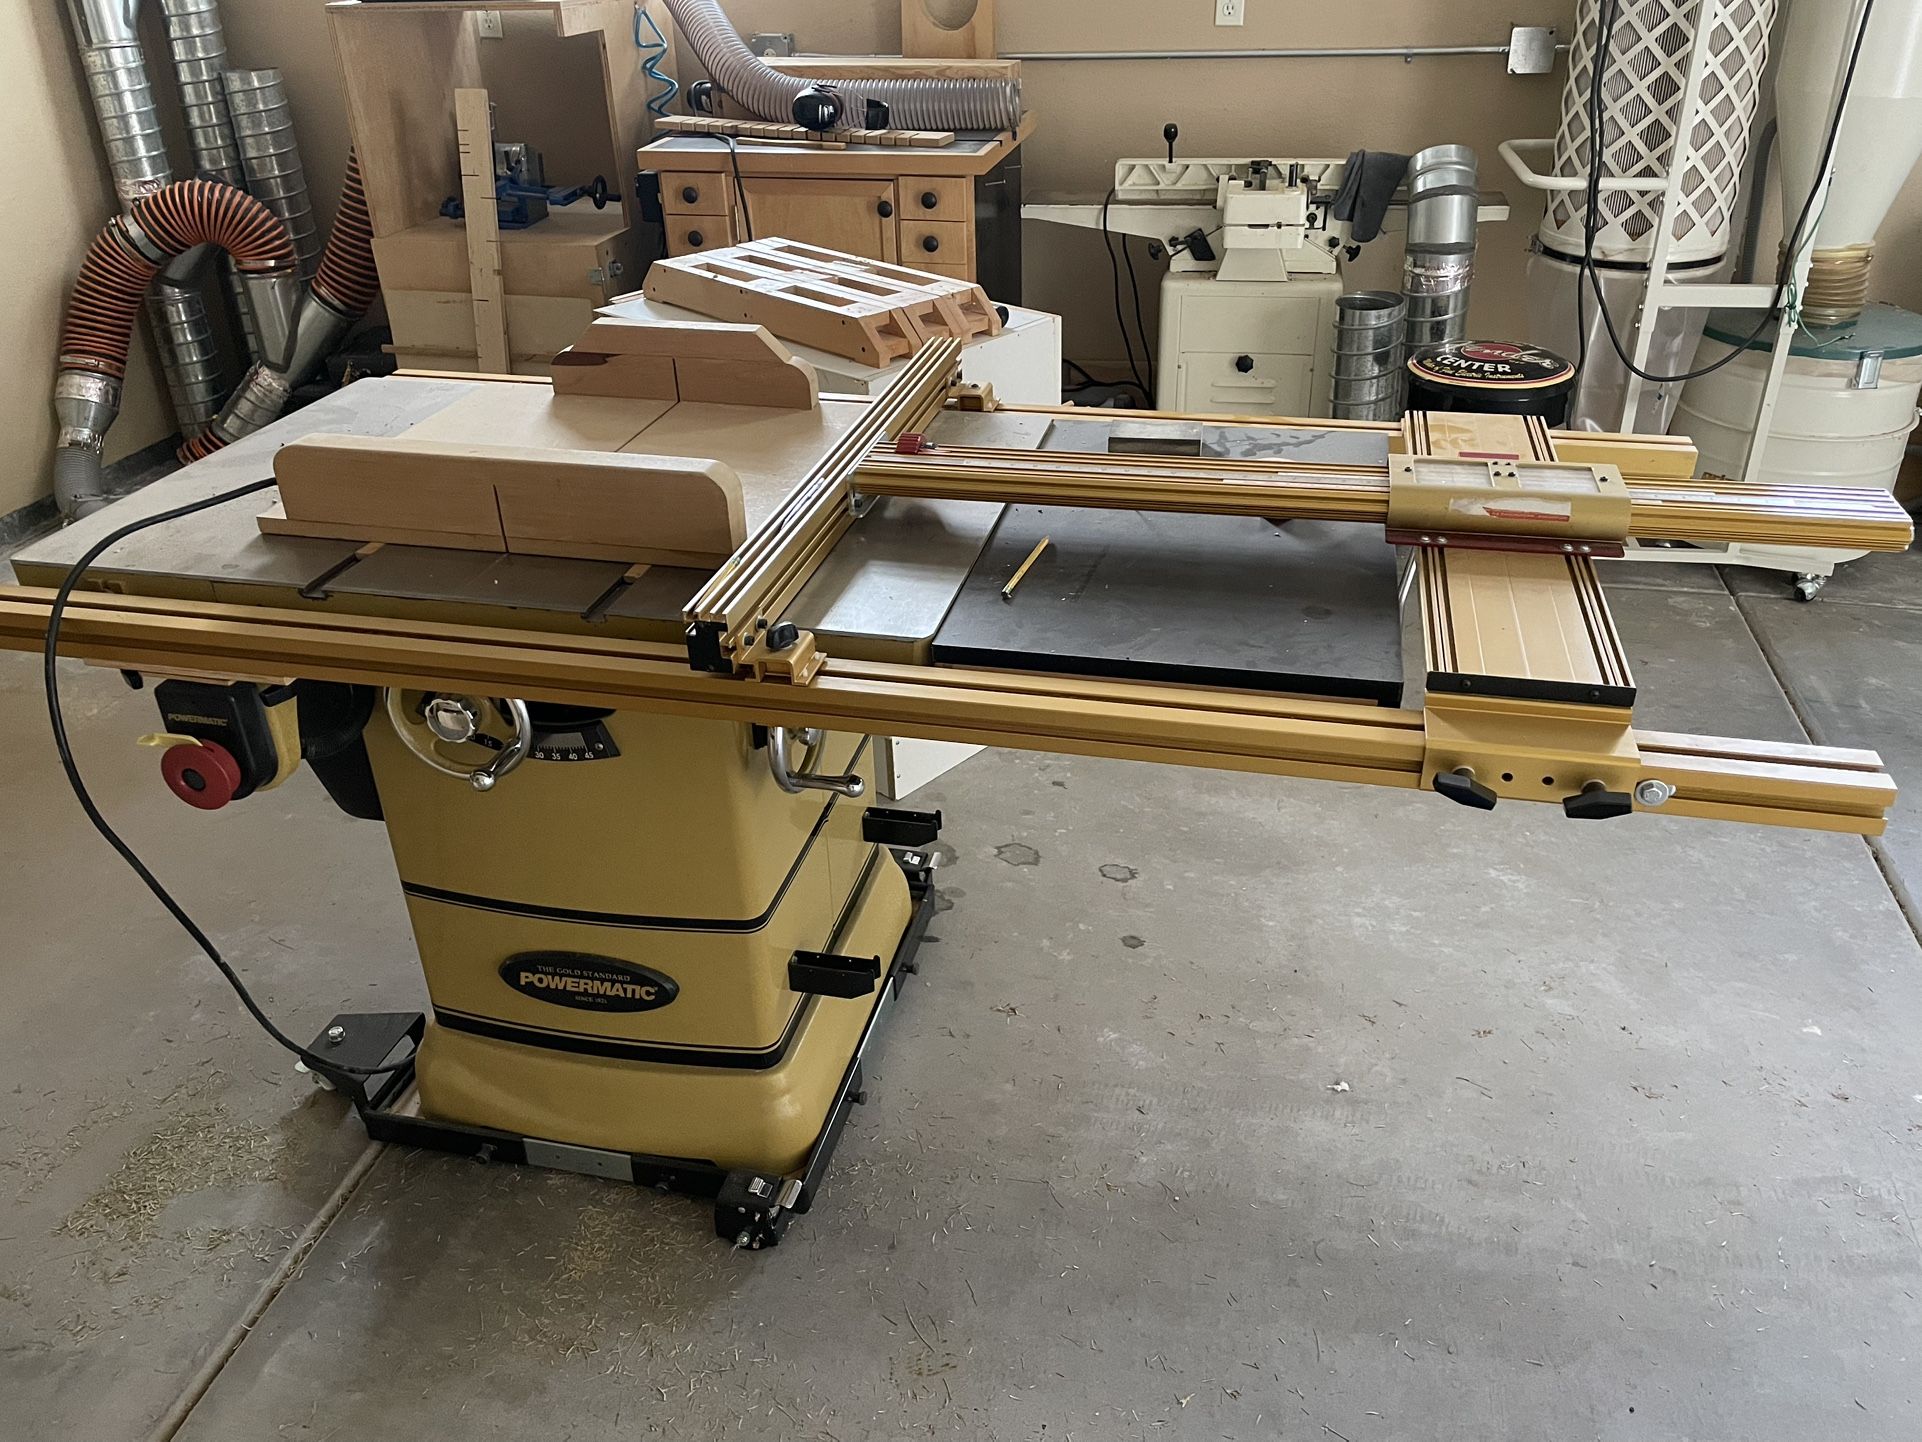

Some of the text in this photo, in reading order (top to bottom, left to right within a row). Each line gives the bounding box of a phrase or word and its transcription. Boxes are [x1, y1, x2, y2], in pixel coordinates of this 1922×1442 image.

[1436, 355, 1511, 373] CENTER
[168, 713, 228, 726] POWERMATIC
[585, 751, 594, 759] 45
[537, 965, 631, 982] THE GOLD STANDARD
[519, 971, 656, 1000] POWERMATIC
